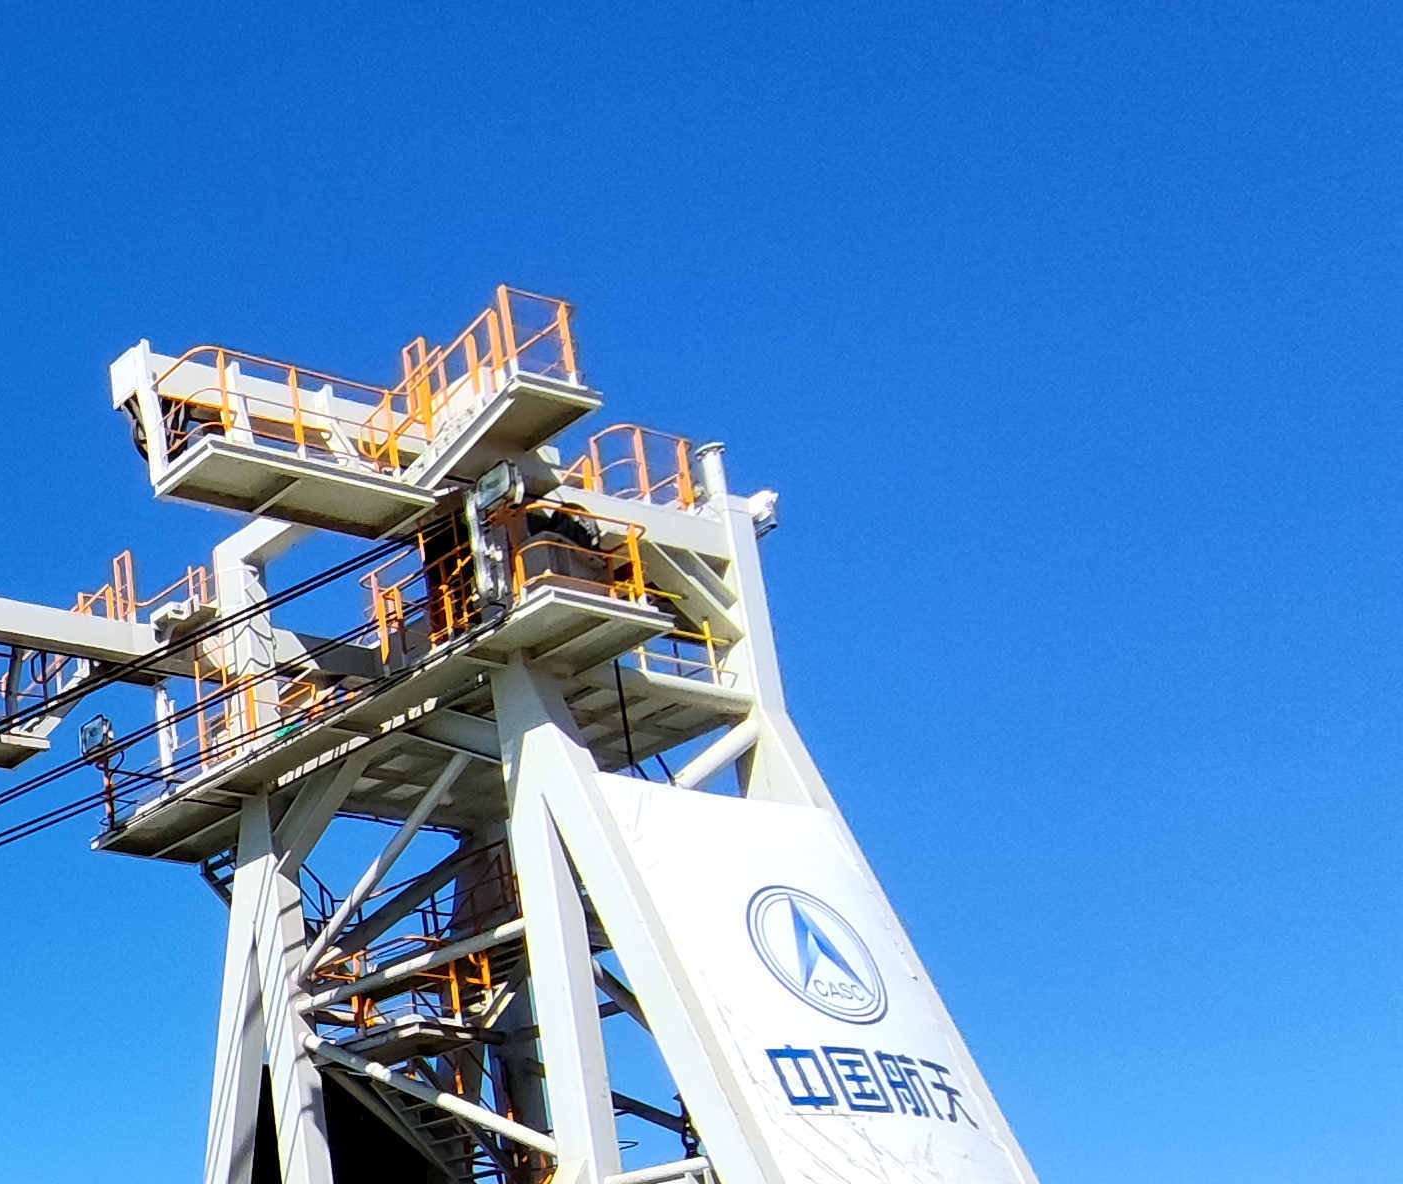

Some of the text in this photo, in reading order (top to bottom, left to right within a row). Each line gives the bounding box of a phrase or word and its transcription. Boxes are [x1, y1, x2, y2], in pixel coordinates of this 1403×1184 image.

[813, 979, 865, 1001] CASC
[764, 1044, 980, 1130] 中国航天
